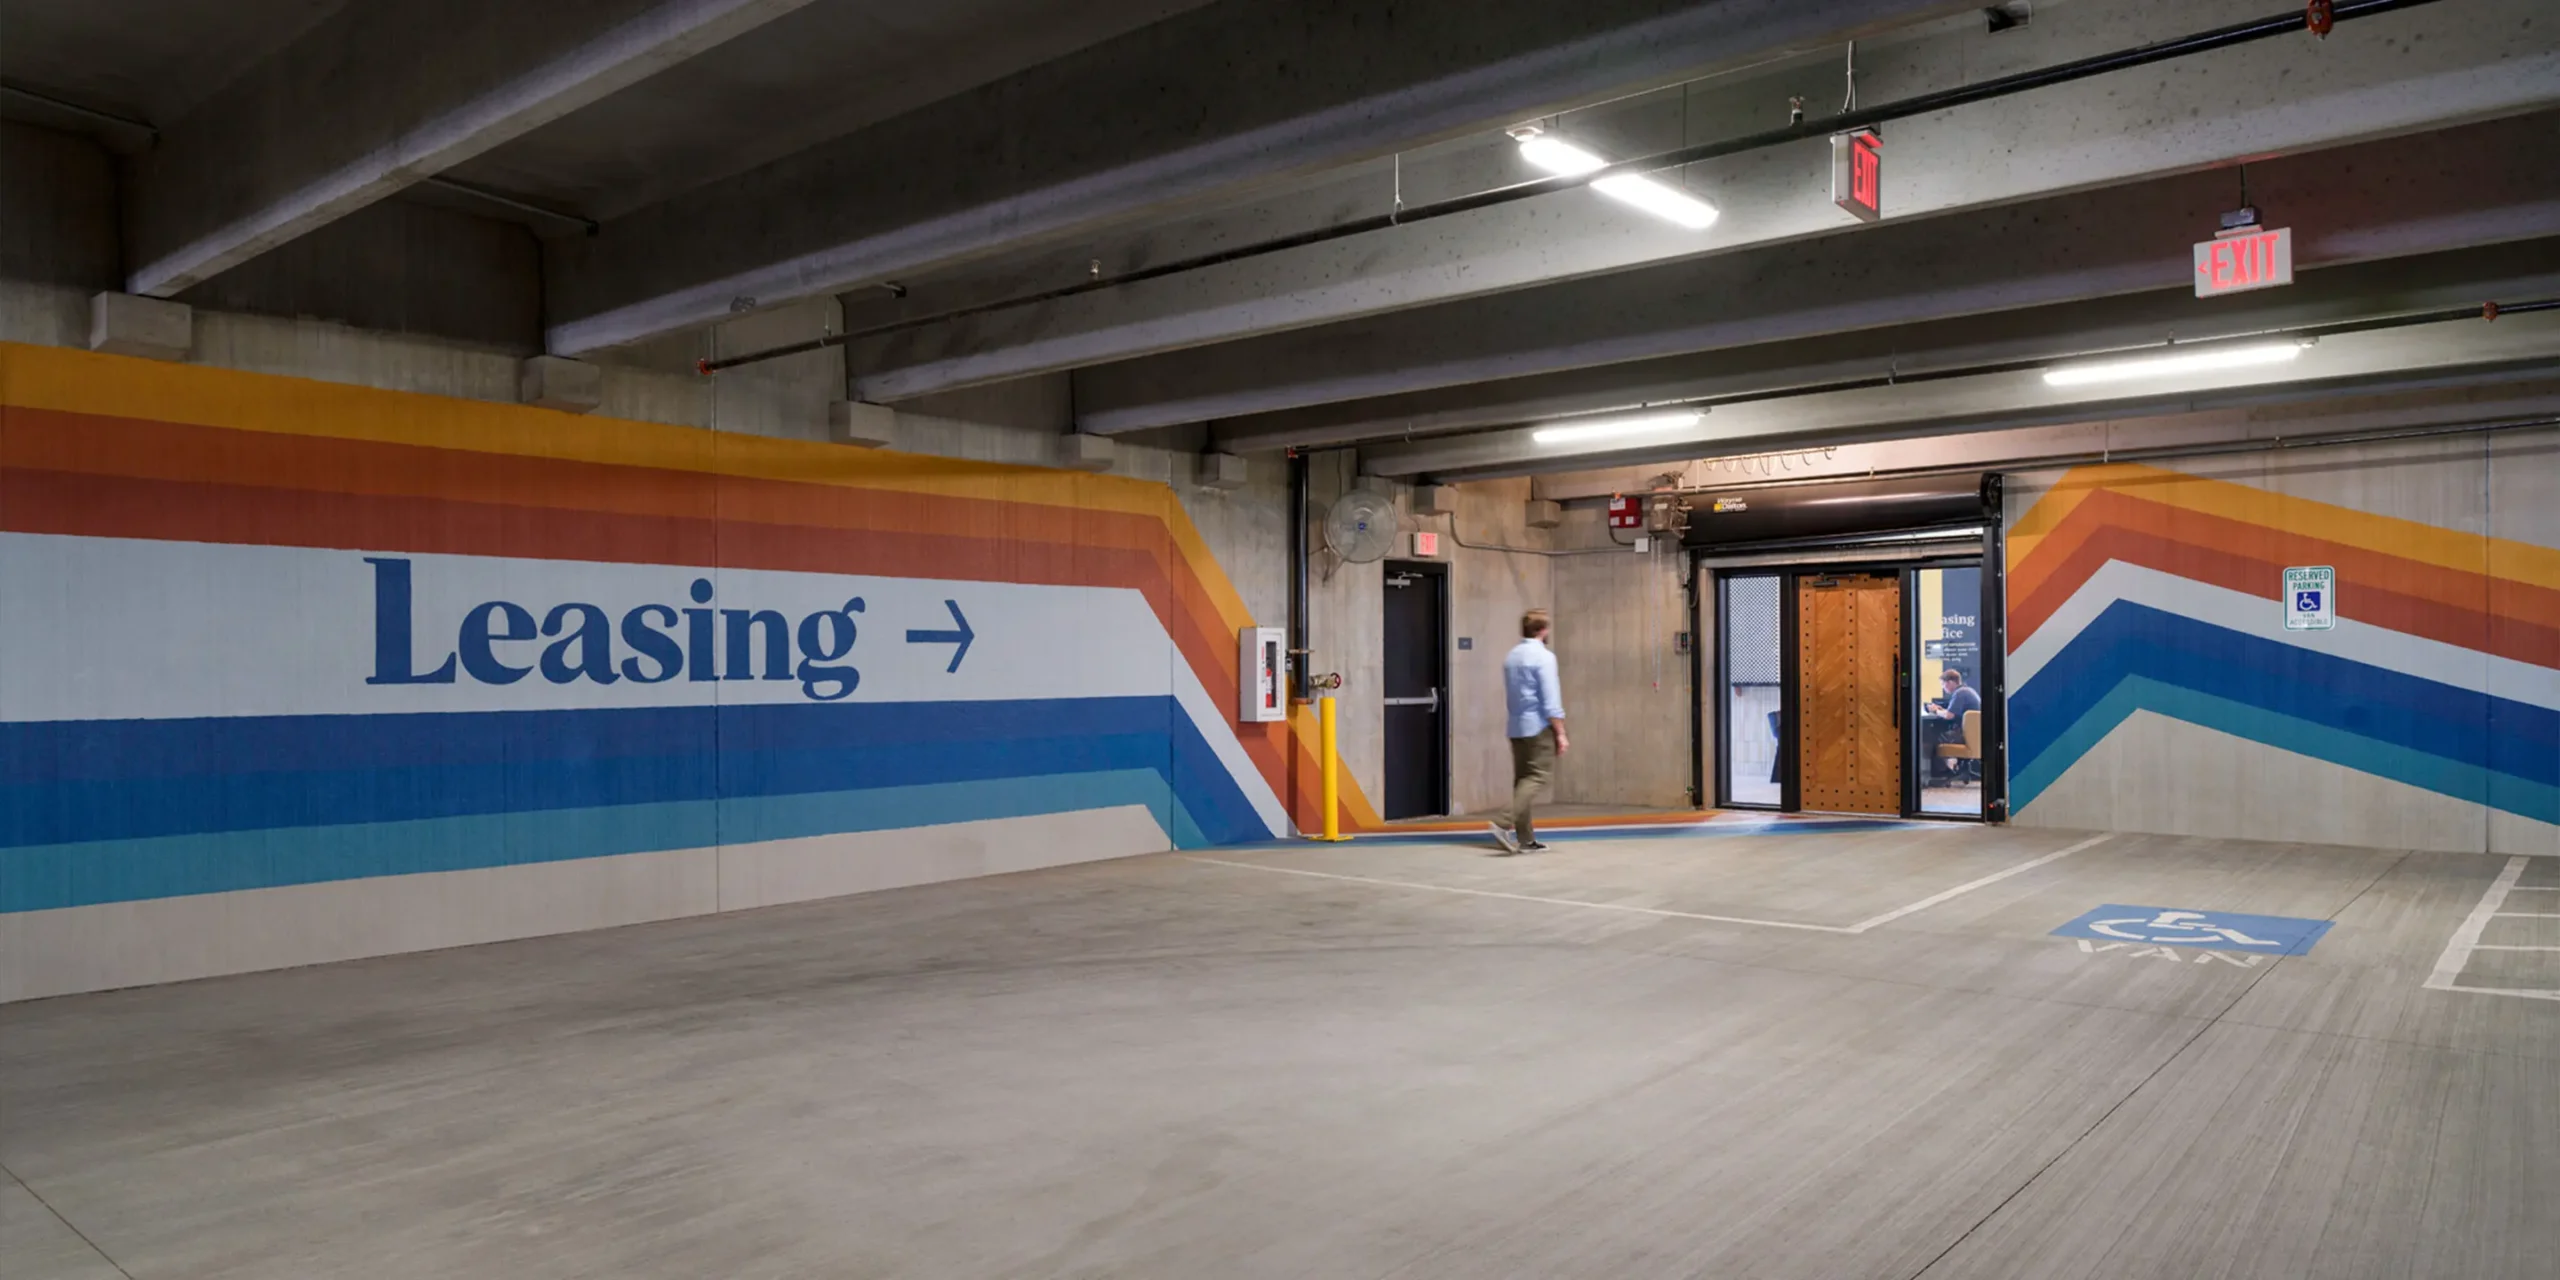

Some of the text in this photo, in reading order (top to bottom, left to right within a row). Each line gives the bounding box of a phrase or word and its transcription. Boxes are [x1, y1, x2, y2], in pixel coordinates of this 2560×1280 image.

[1853, 140, 1879, 211] EXIT
[2210, 233, 2279, 289] EXIT
[2289, 570, 2329, 581] RESERVED
[2293, 582, 2325, 590] PARKING
[363, 557, 866, 700] Leasing
[2077, 939, 2264, 968] VAN
